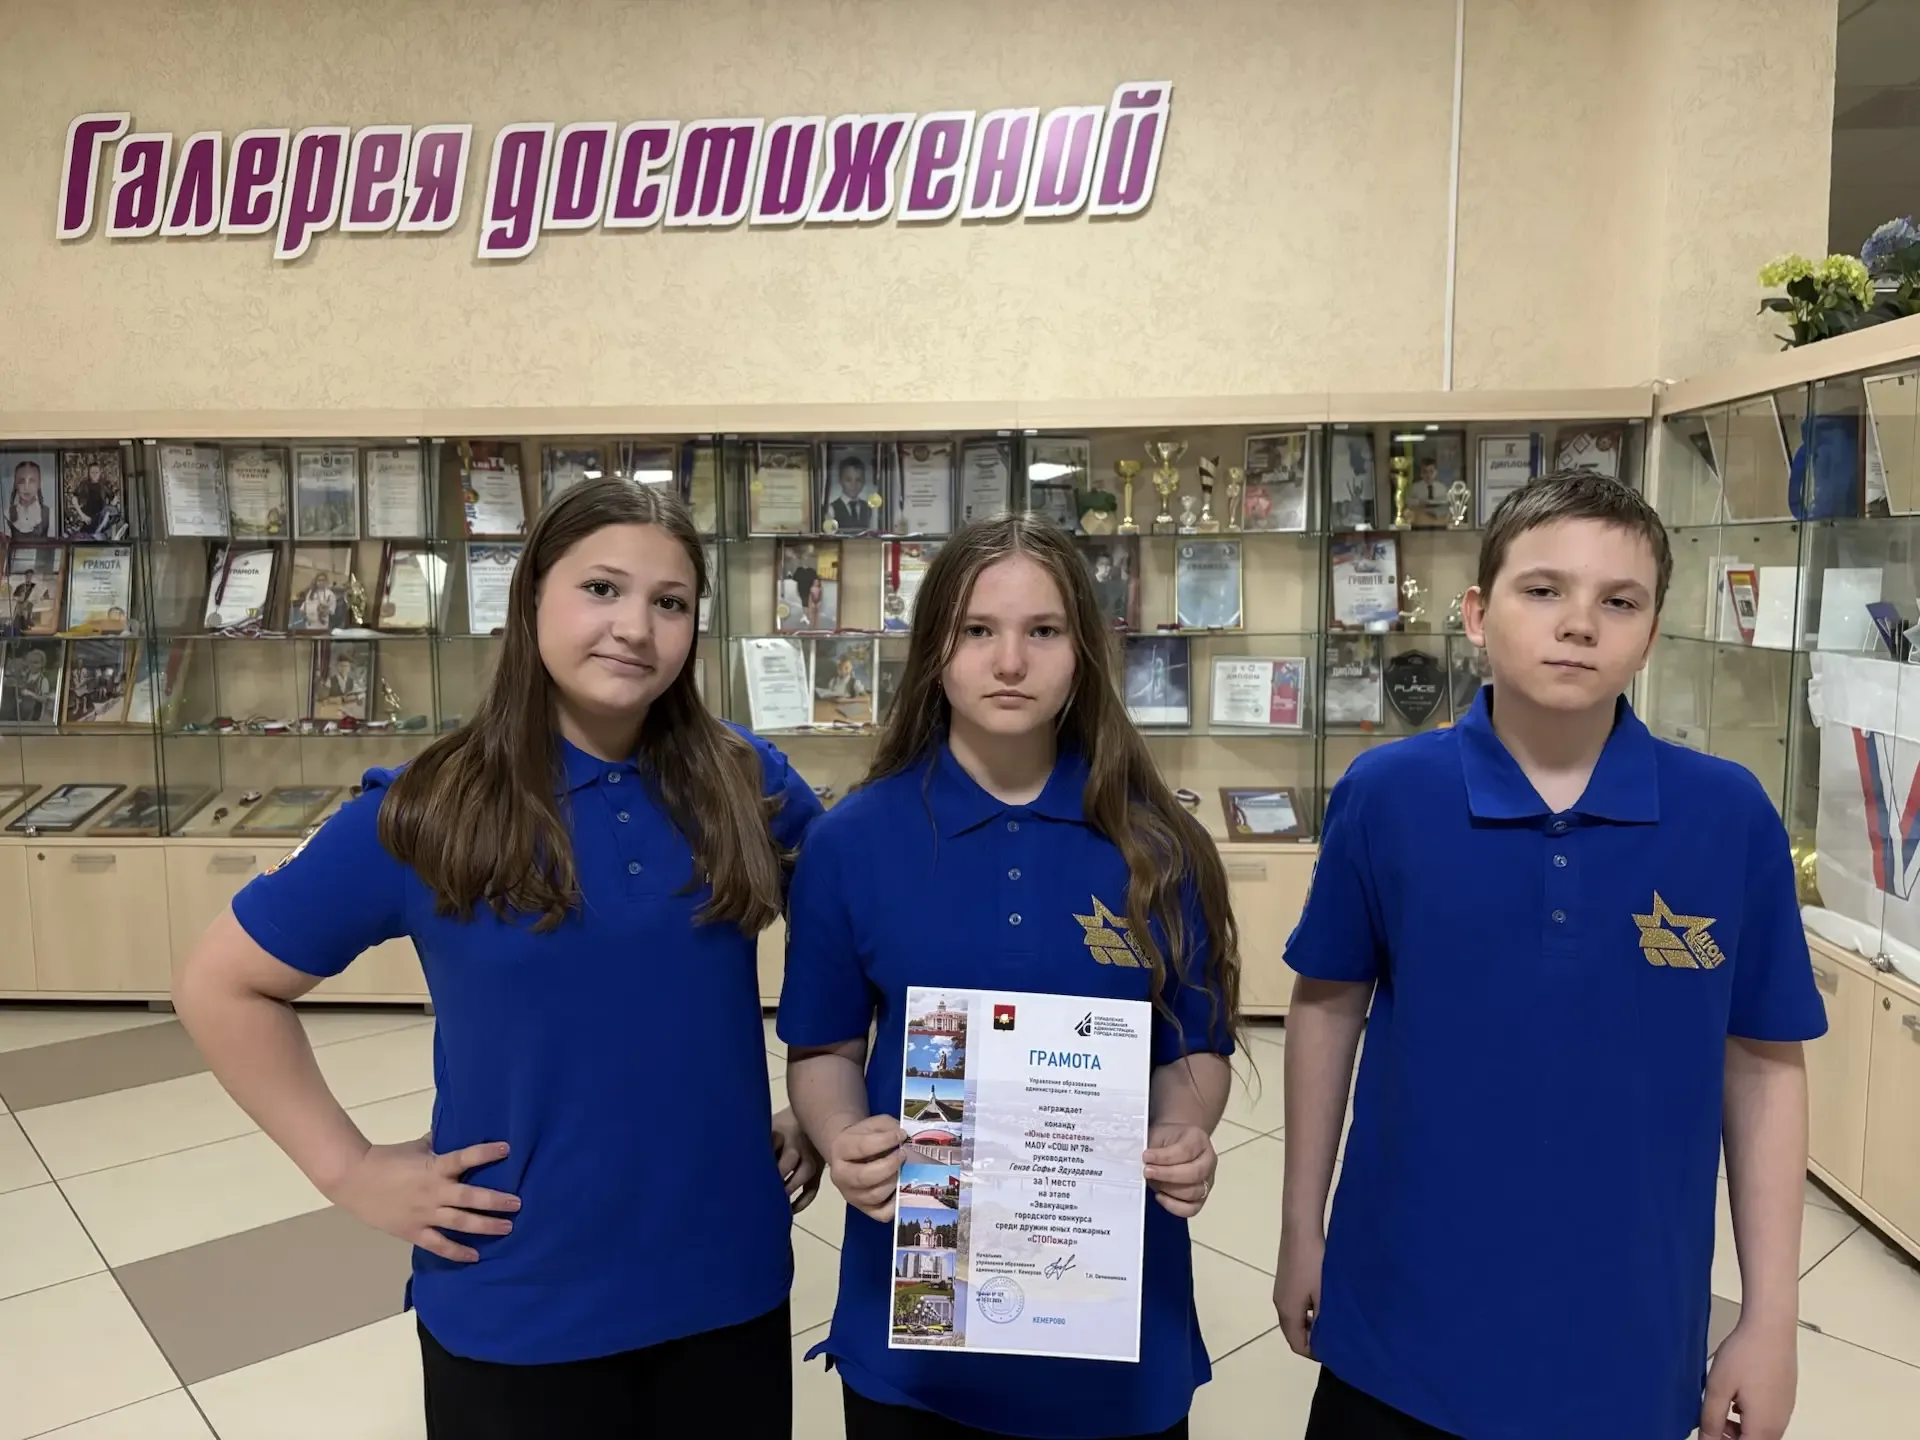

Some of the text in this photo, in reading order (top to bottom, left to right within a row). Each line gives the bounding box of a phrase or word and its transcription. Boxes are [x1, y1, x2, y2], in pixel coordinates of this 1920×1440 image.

[57, 81, 1171, 259] Галерея достижений
[83, 560, 121, 570] ГРАМОТА
[1029, 1050, 1101, 1070] ГРАМОТА
[1029, 1077, 1097, 1088] Управление образования
[1025, 1086, 1067, 1094] администрации
[1074, 1089, 1100, 1097] Кемерово
[1038, 1105, 1083, 1115] награждает
[1044, 1120, 1076, 1130] команду
[1024, 1130, 1095, 1141] «Юные спасатели»
[1025, 1141, 1046, 1151] МАОУ
[1048, 1142, 1068, 1151] «СОШ
[1070, 1143, 1079, 1152] №
[1033, 1153, 1084, 1164] руководитель
[1009, 1163, 1103, 1176] Гензе Софья Эдуардовна
[1045, 1177, 1049, 1186] 1
[1051, 1179, 1076, 1188] место
[1049, 1191, 1071, 1199] этапе
[1030, 1200, 1078, 1211] «Эвакуация»
[1014, 1211, 1092, 1224] городского конкурса
[995, 1223, 1111, 1236] среди дружин юных пожарных
[1027, 1235, 1078, 1246] «СТОПожар»
[1032, 1316, 1066, 1326] КЕМЕРОВО
